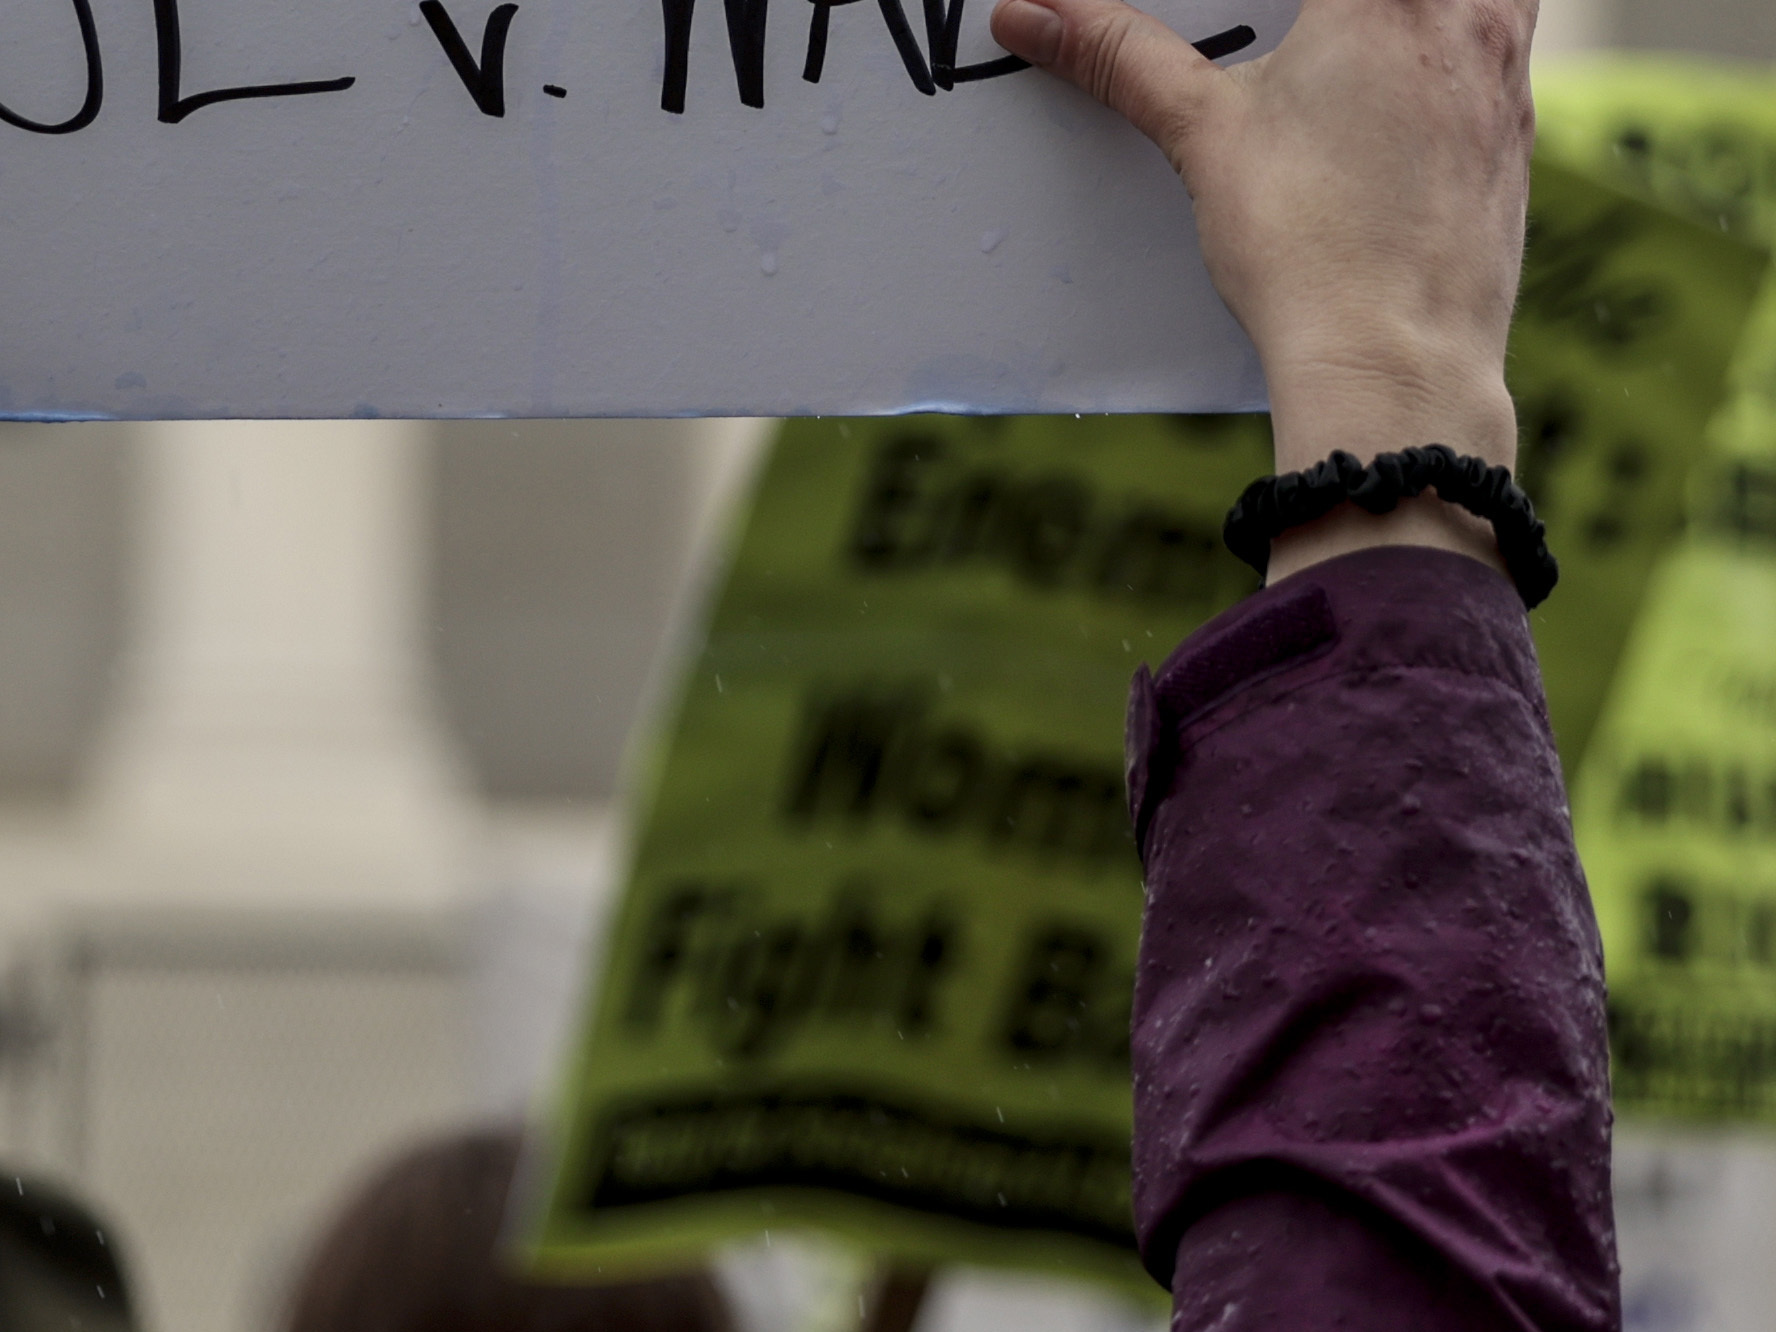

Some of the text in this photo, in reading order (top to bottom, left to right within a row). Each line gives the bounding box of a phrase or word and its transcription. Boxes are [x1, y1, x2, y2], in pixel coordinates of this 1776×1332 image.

[844, 426, 1229, 618] Enem
[780, 674, 1134, 871] Wom
[622, 871, 964, 1066] Fight
